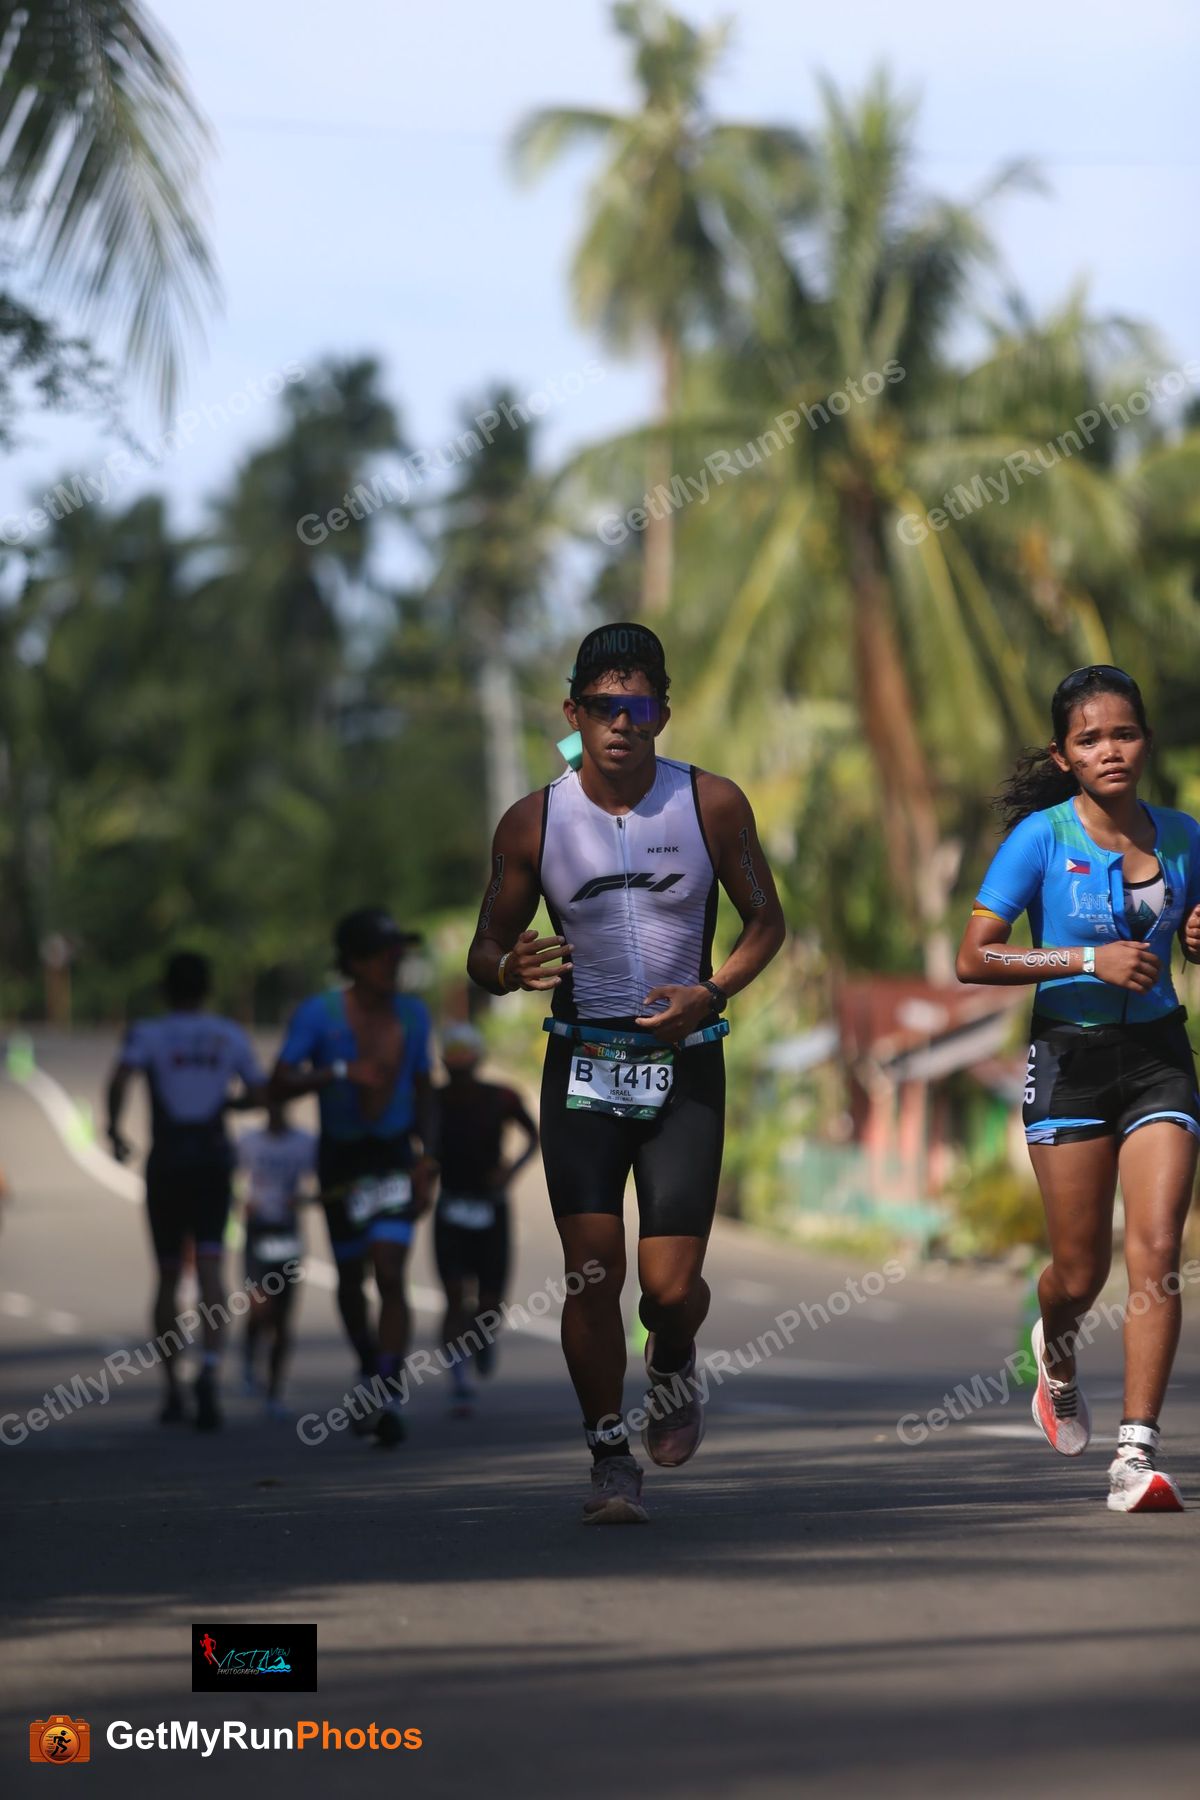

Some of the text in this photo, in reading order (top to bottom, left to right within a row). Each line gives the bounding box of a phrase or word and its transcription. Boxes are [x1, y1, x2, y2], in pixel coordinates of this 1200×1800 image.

[647, 846, 680, 854] NENK
[984, 950, 1070, 968] 1192
[575, 1059, 670, 1092] B 1413
[609, 1089, 632, 1097] ISRAEL
